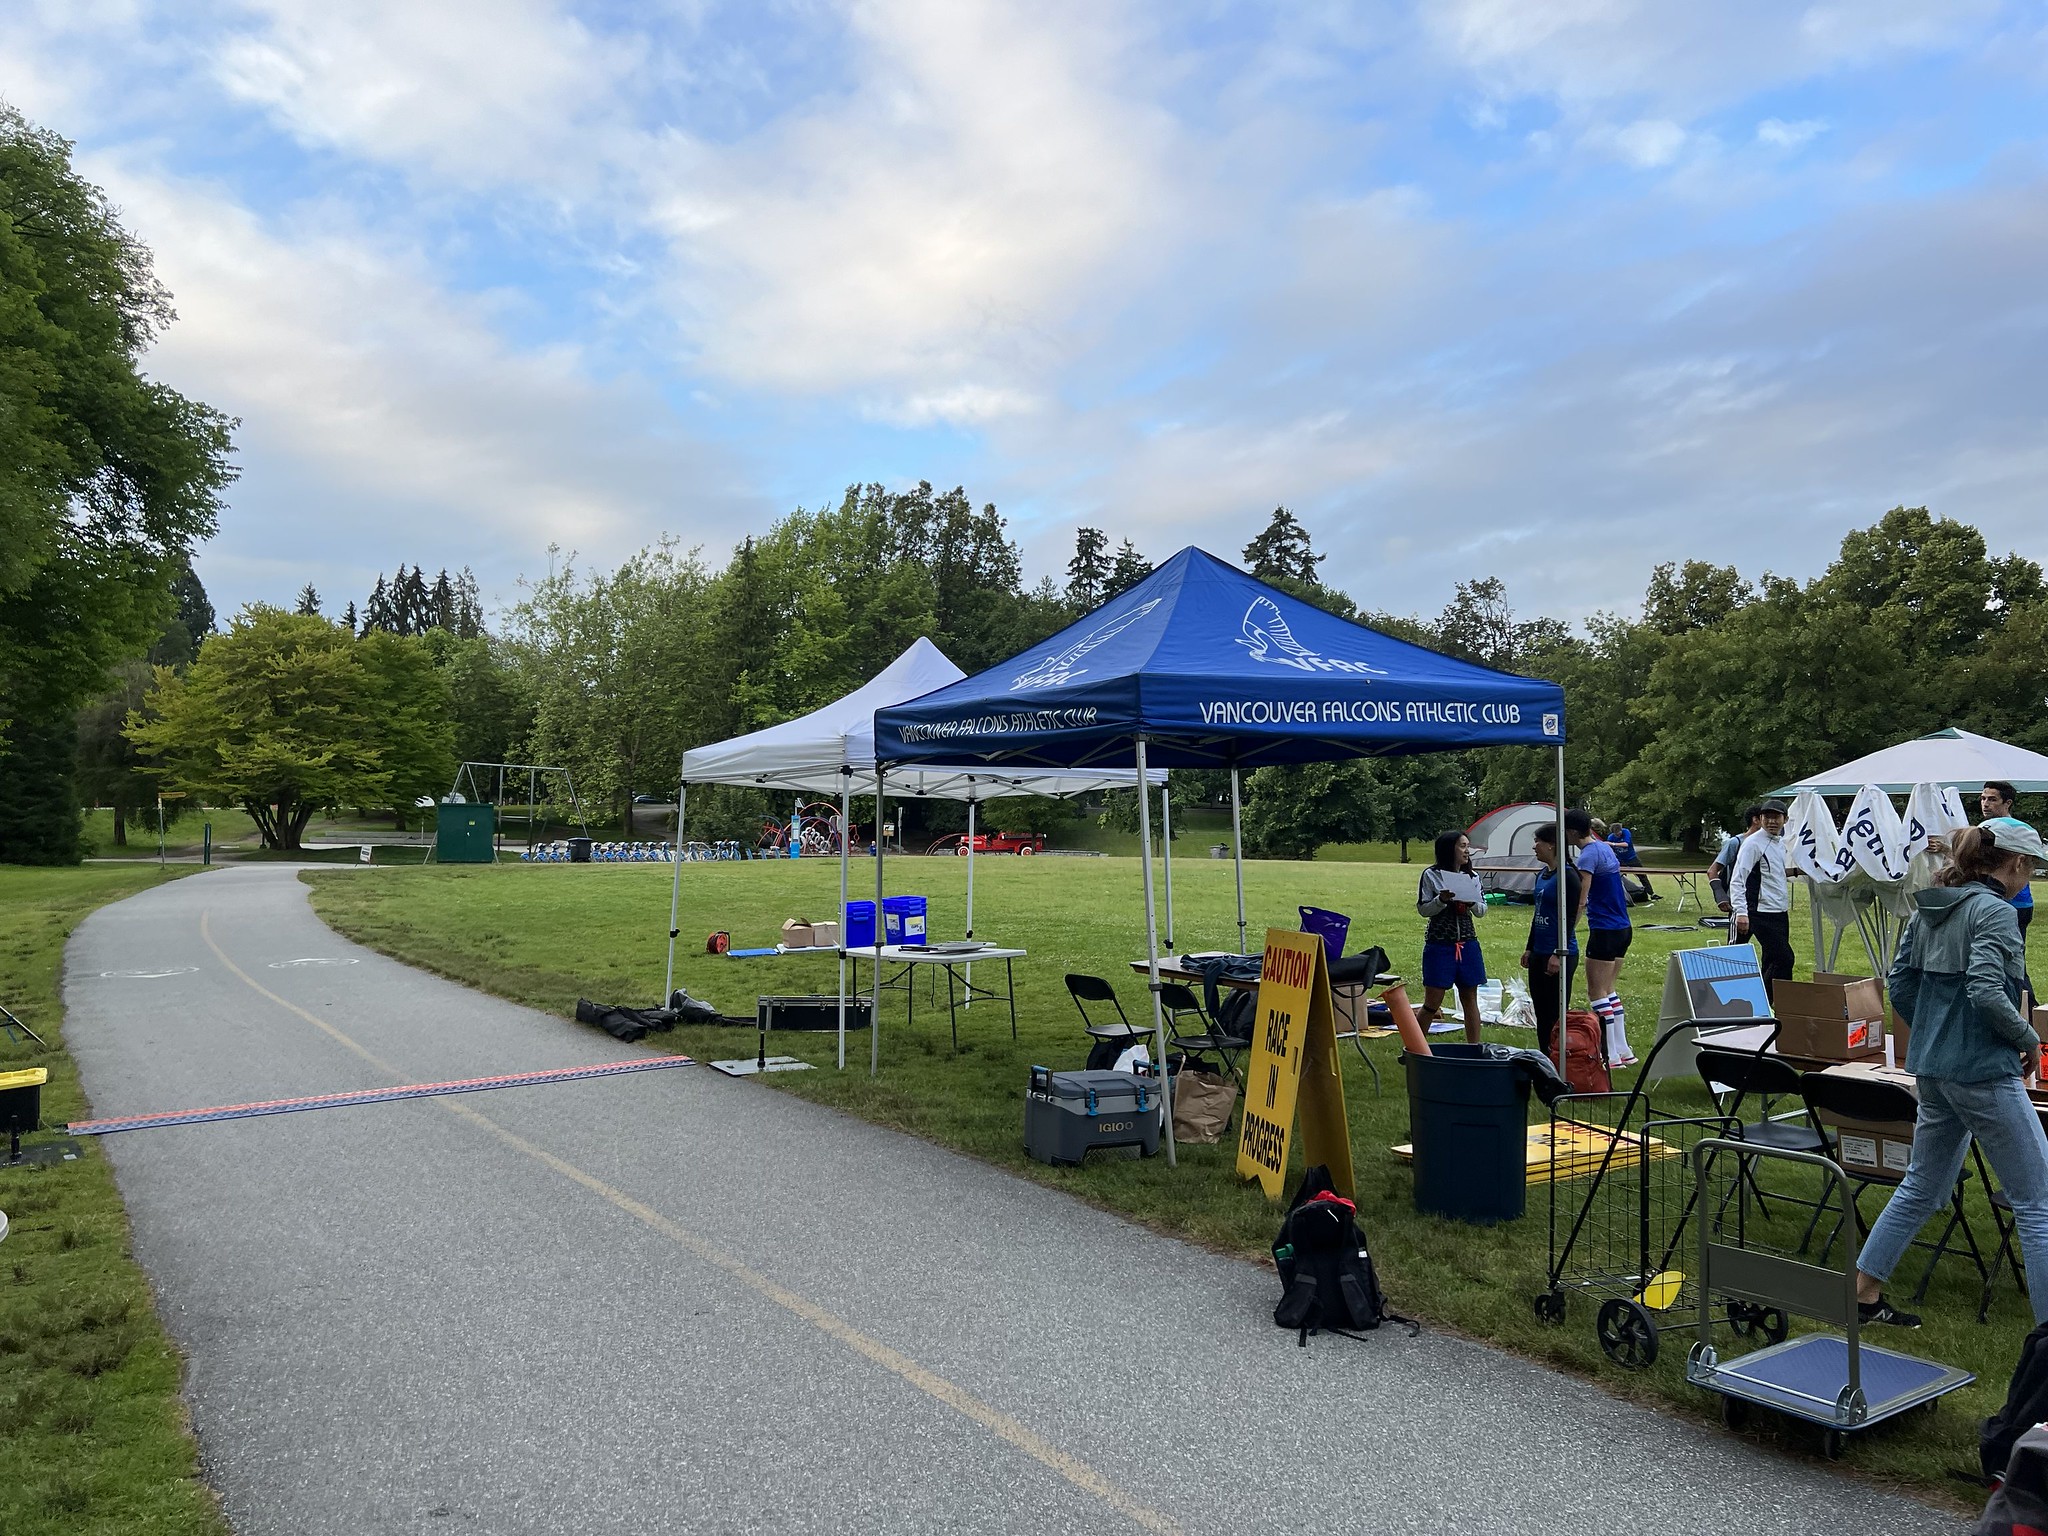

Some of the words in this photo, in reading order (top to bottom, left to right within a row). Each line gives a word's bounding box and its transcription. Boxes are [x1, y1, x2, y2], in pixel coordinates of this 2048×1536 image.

[1274, 656, 1389, 675] VFAC
[898, 721, 958, 744] VANCOUVER
[955, 714, 1009, 736] FALCONS
[1009, 709, 1065, 733] ATHLETIC
[1063, 706, 1098, 727] CLUB
[1199, 701, 1318, 724] VANCOUVER
[1322, 701, 1401, 723] FALCONS
[1405, 701, 1479, 723] ATHLETIC
[1482, 703, 1521, 724] CLUB
[1263, 944, 1312, 990] CAUTION
[1265, 1008, 1291, 1058] RACE
[1265, 1063, 1280, 1110] IN
[1098, 1121, 1135, 1133] IGLOO
[1241, 1110, 1285, 1175] PROGRESS
